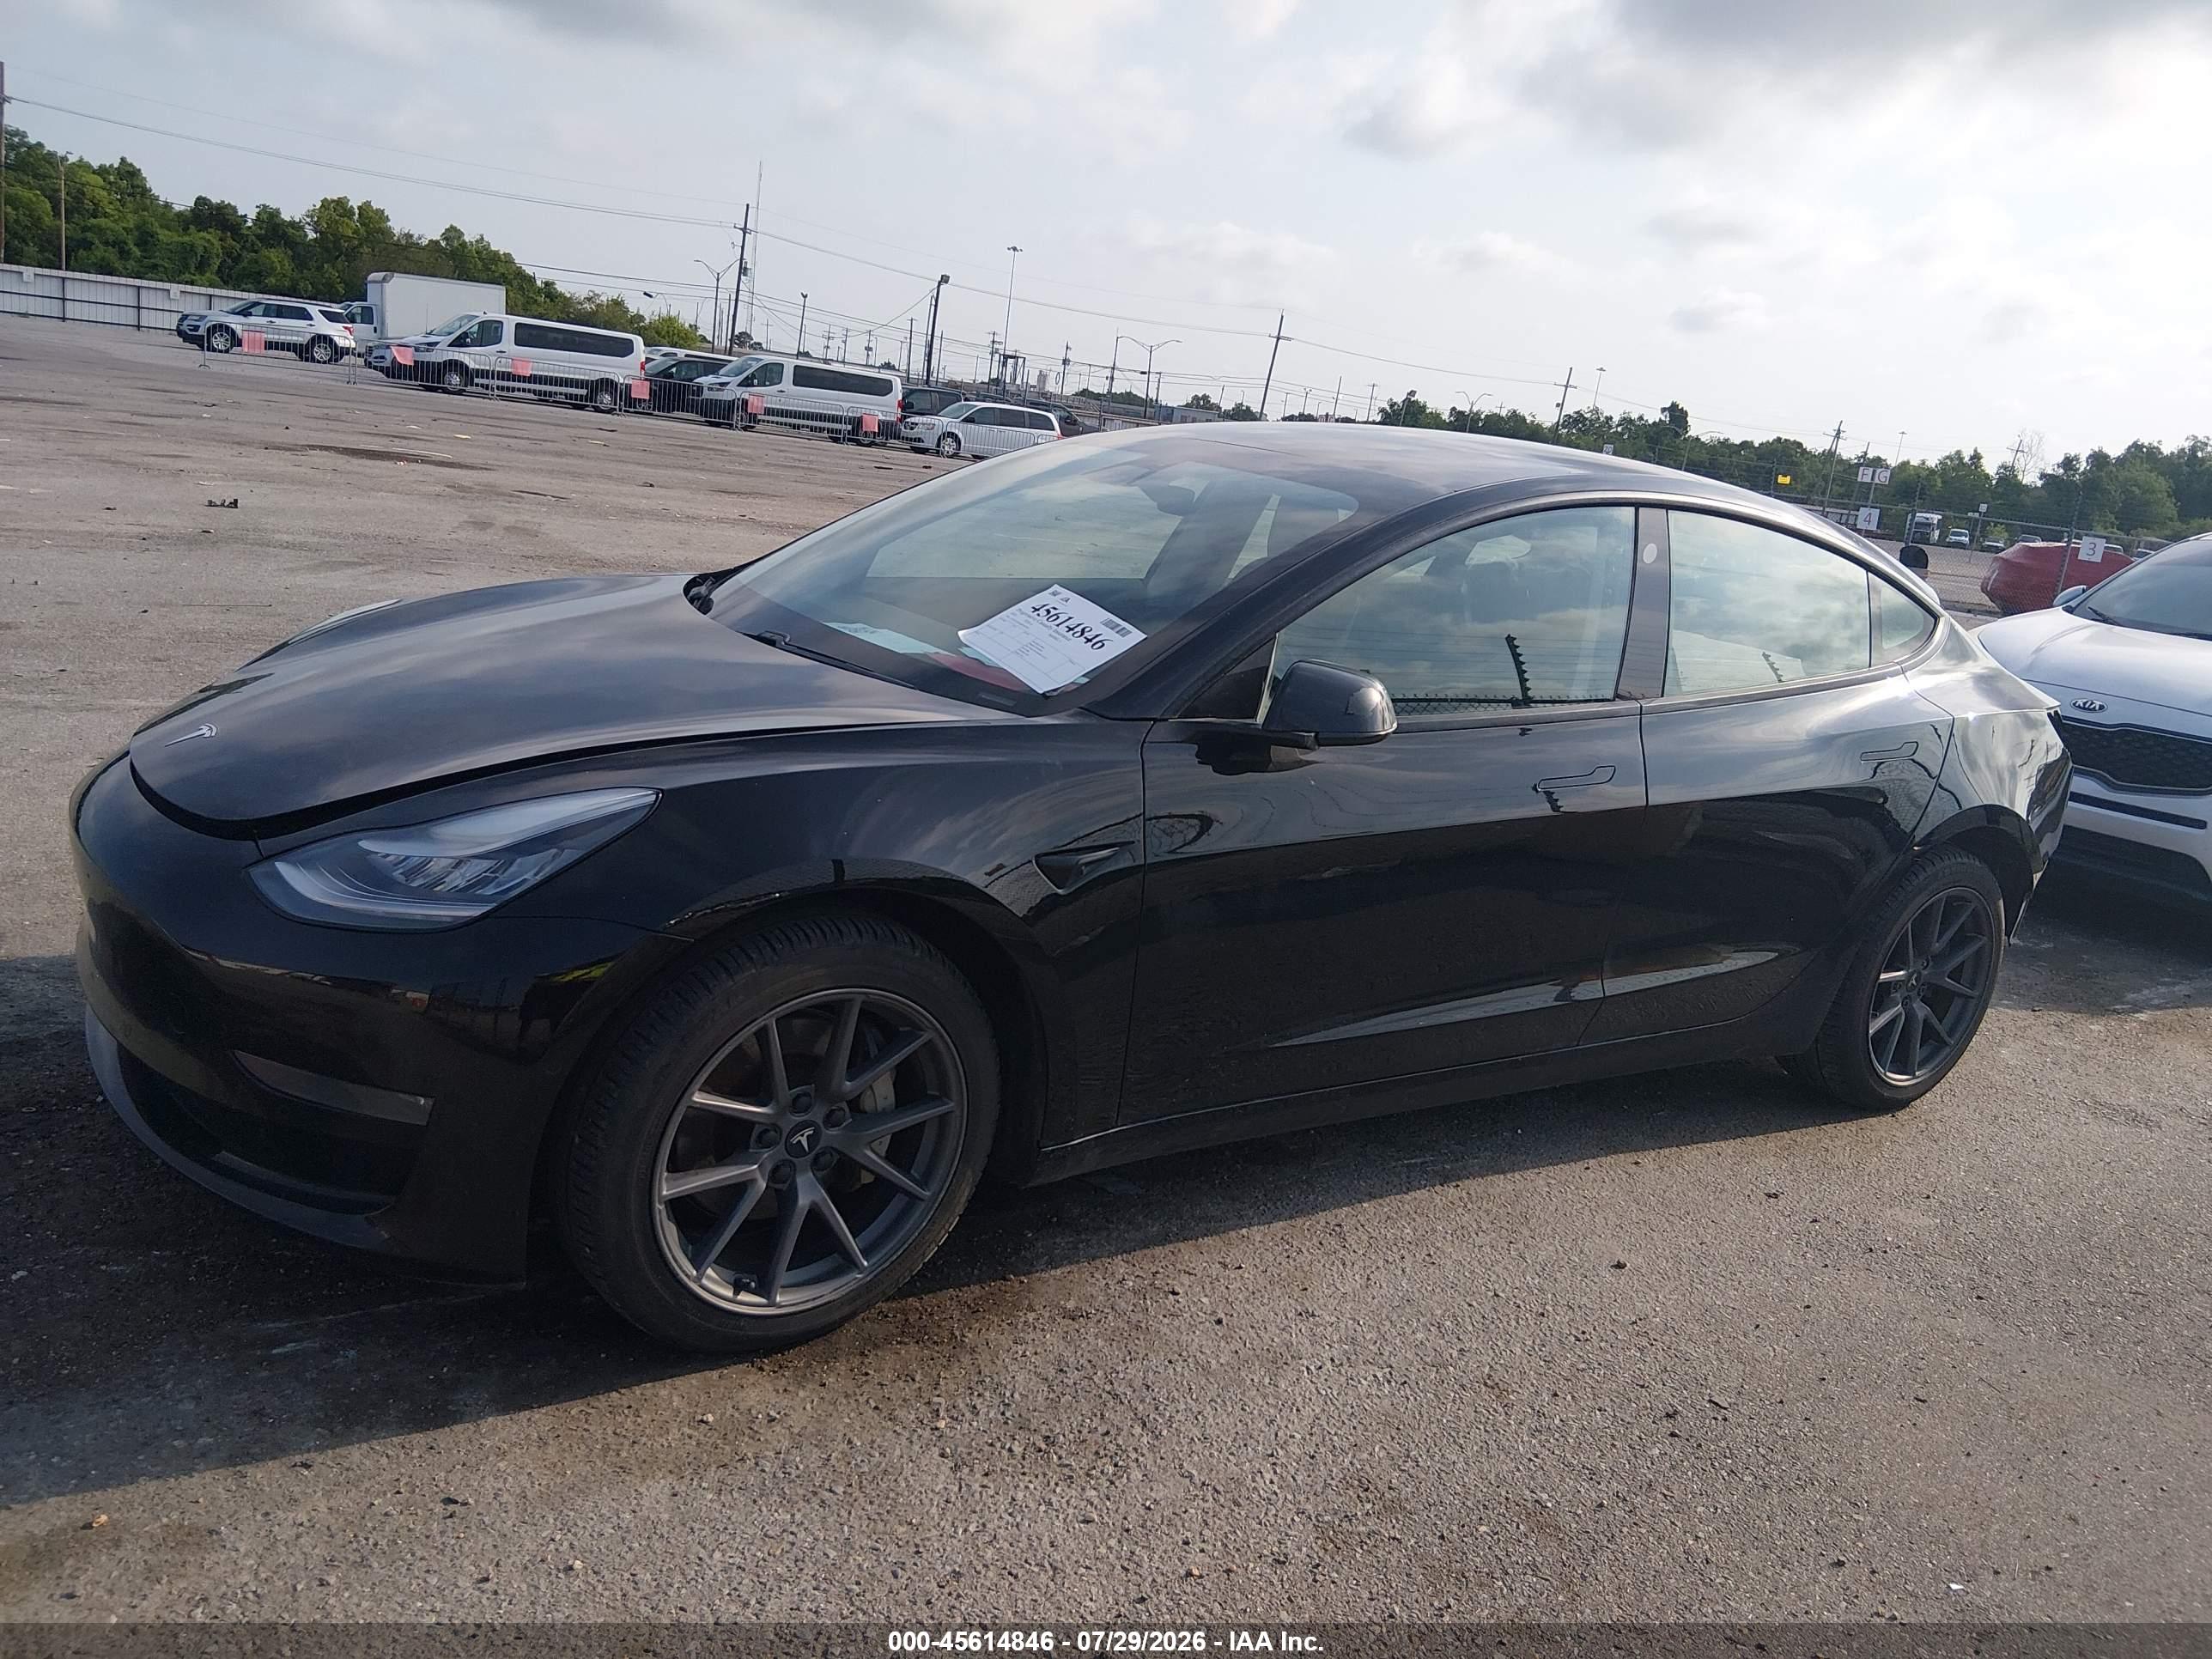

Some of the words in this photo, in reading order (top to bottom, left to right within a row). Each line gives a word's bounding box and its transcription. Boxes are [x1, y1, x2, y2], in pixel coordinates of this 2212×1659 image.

[1861, 468, 1869, 481] F
[1877, 470, 1888, 483] G
[1863, 512, 1873, 526] 4
[2086, 542, 2097, 556] 3
[1031, 603, 1114, 650] 45614846
[2074, 699, 2103, 711] KIA
